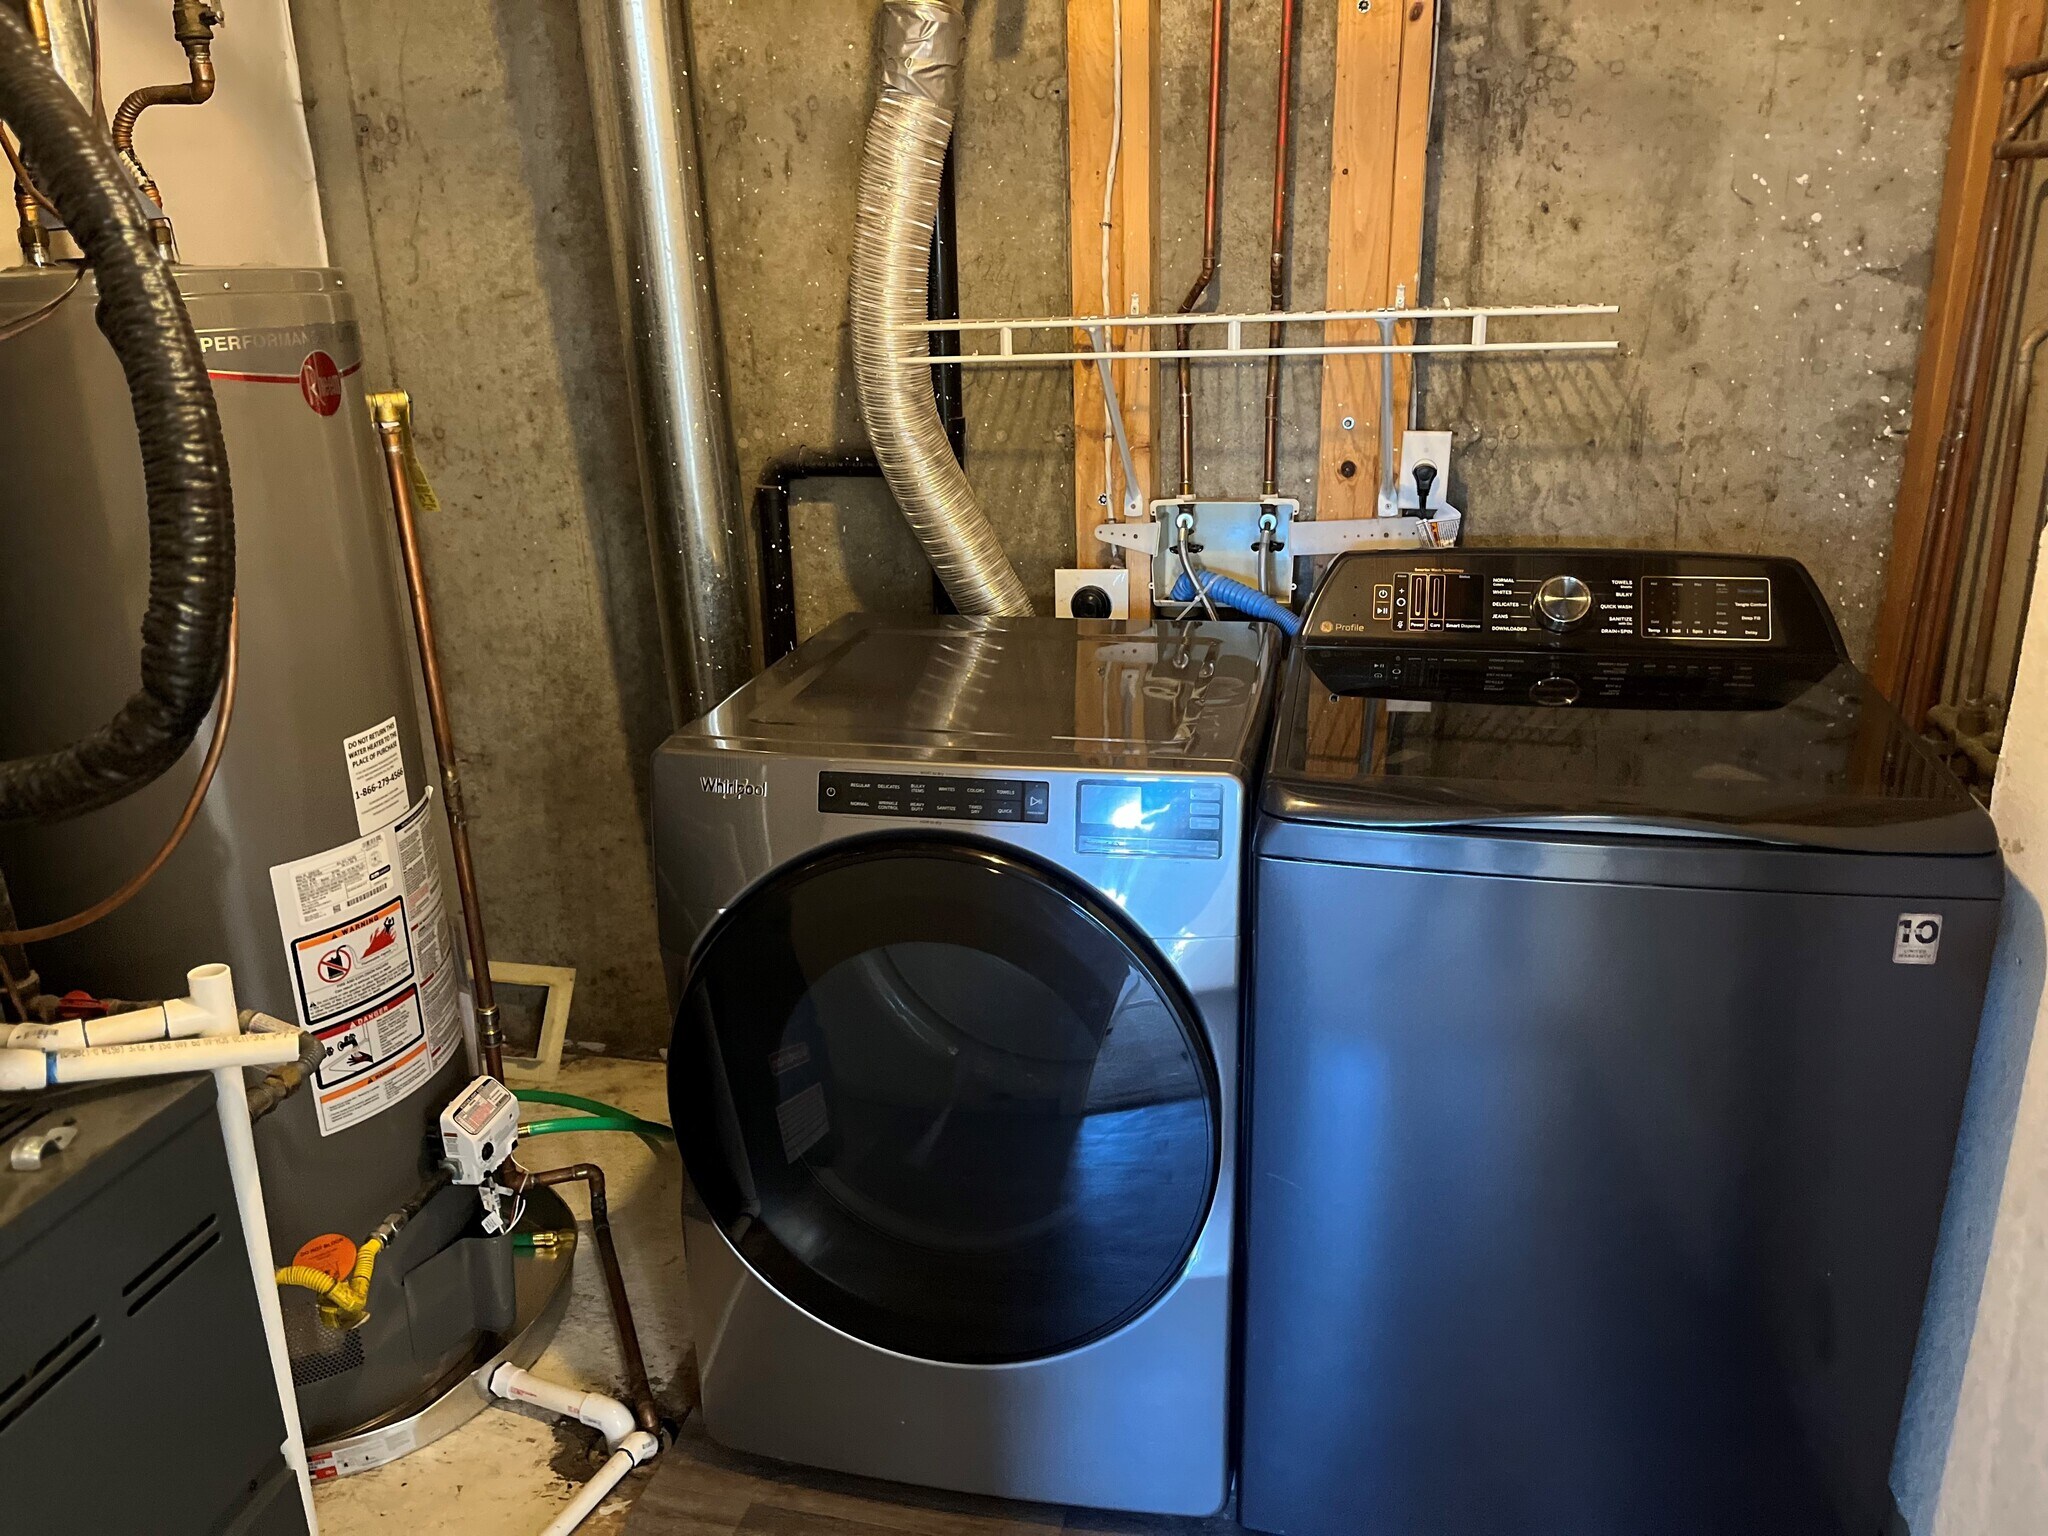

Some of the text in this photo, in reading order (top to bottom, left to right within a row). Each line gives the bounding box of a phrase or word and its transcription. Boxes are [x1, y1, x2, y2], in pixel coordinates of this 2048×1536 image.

[1335, 623, 1365, 632] Profile
[348, 722, 395, 750] DO NOT RETURN THIS
[348, 746, 367, 759] WATER
[367, 738, 385, 751] HEATER
[390, 730, 398, 740] THE
[352, 740, 398, 768] PLACE OF PURCHASE
[355, 768, 404, 800] 1-866-279-4566
[700, 776, 768, 800] Whirlpool
[341, 914, 379, 936] WARNING
[1898, 919, 1939, 944] 10
[358, 1005, 389, 1026] DANGER
